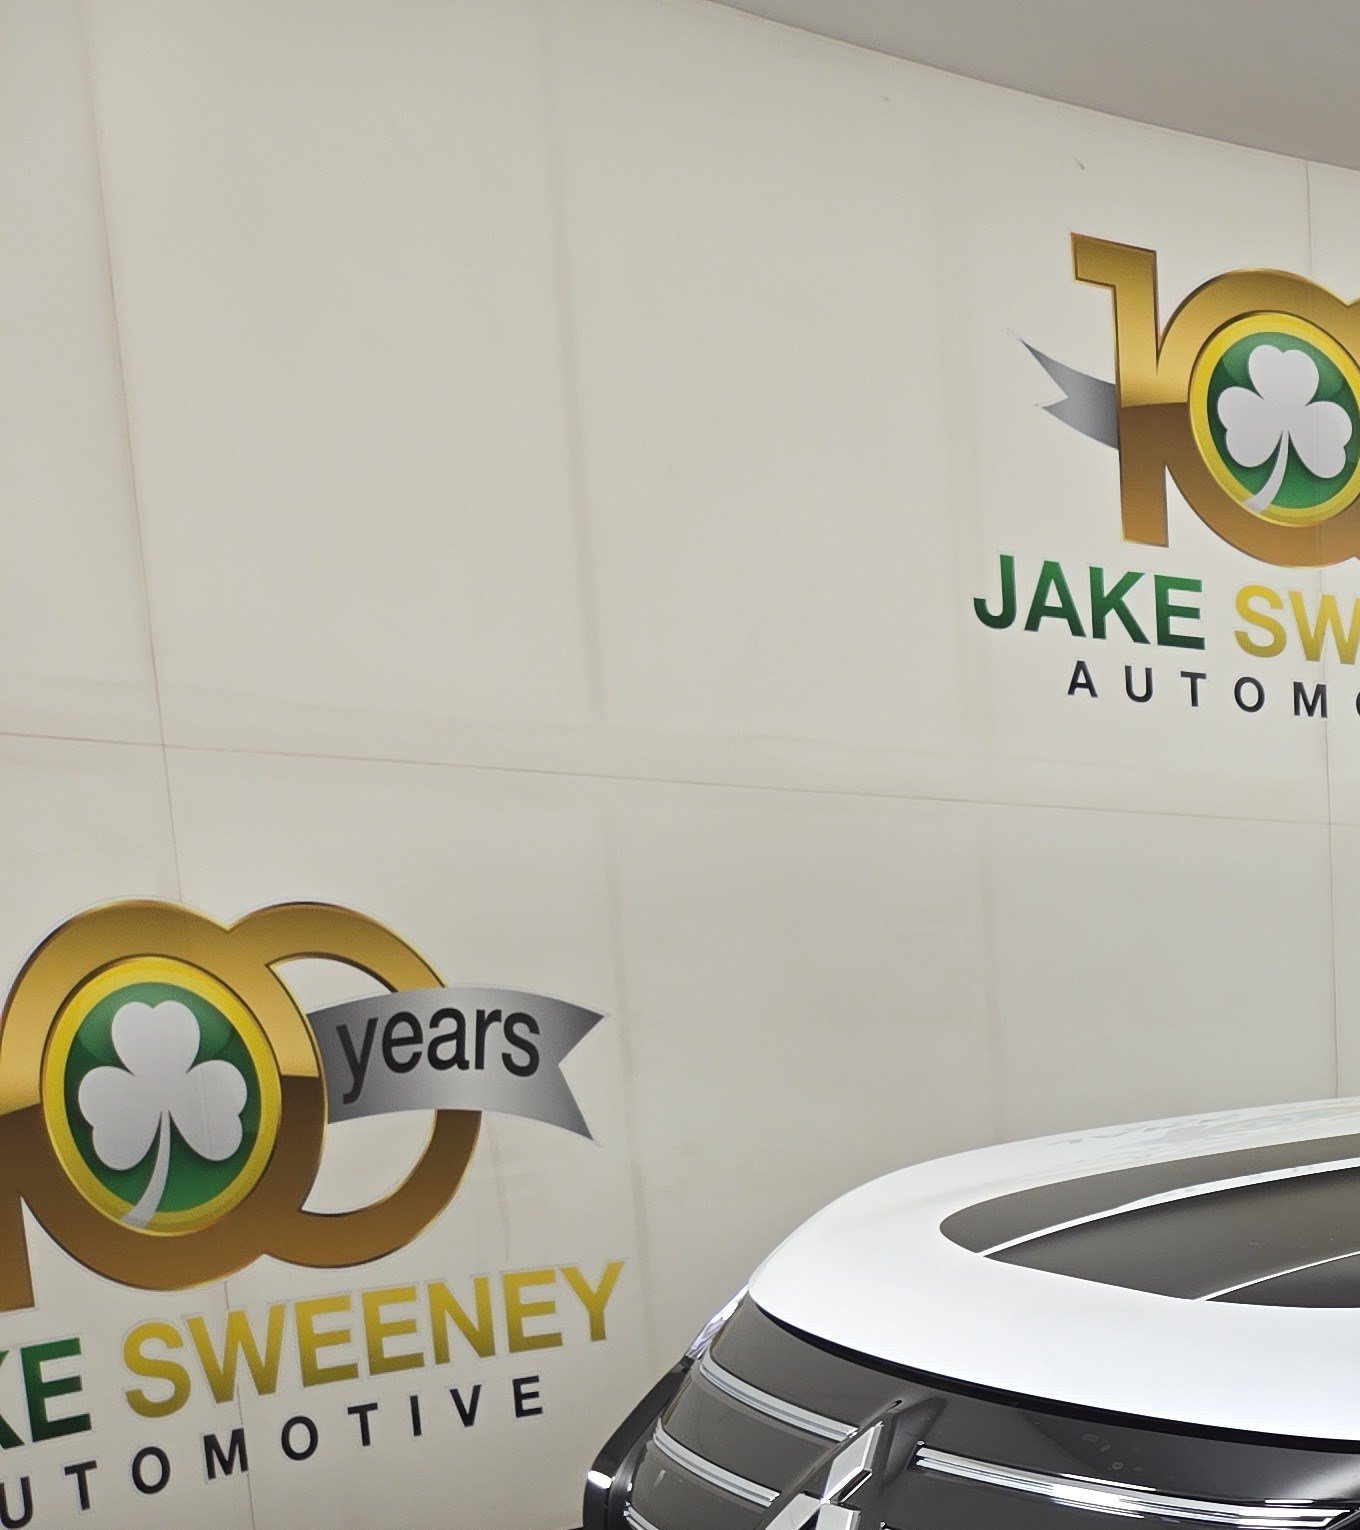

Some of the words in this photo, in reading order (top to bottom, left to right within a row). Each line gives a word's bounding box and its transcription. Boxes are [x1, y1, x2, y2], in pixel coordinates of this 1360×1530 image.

[974, 554, 1206, 650] JAKE
[335, 1006, 541, 1105] years
[122, 1260, 626, 1420] SWEENEY
[0, 1375, 544, 1530] UTOMOTIVE
